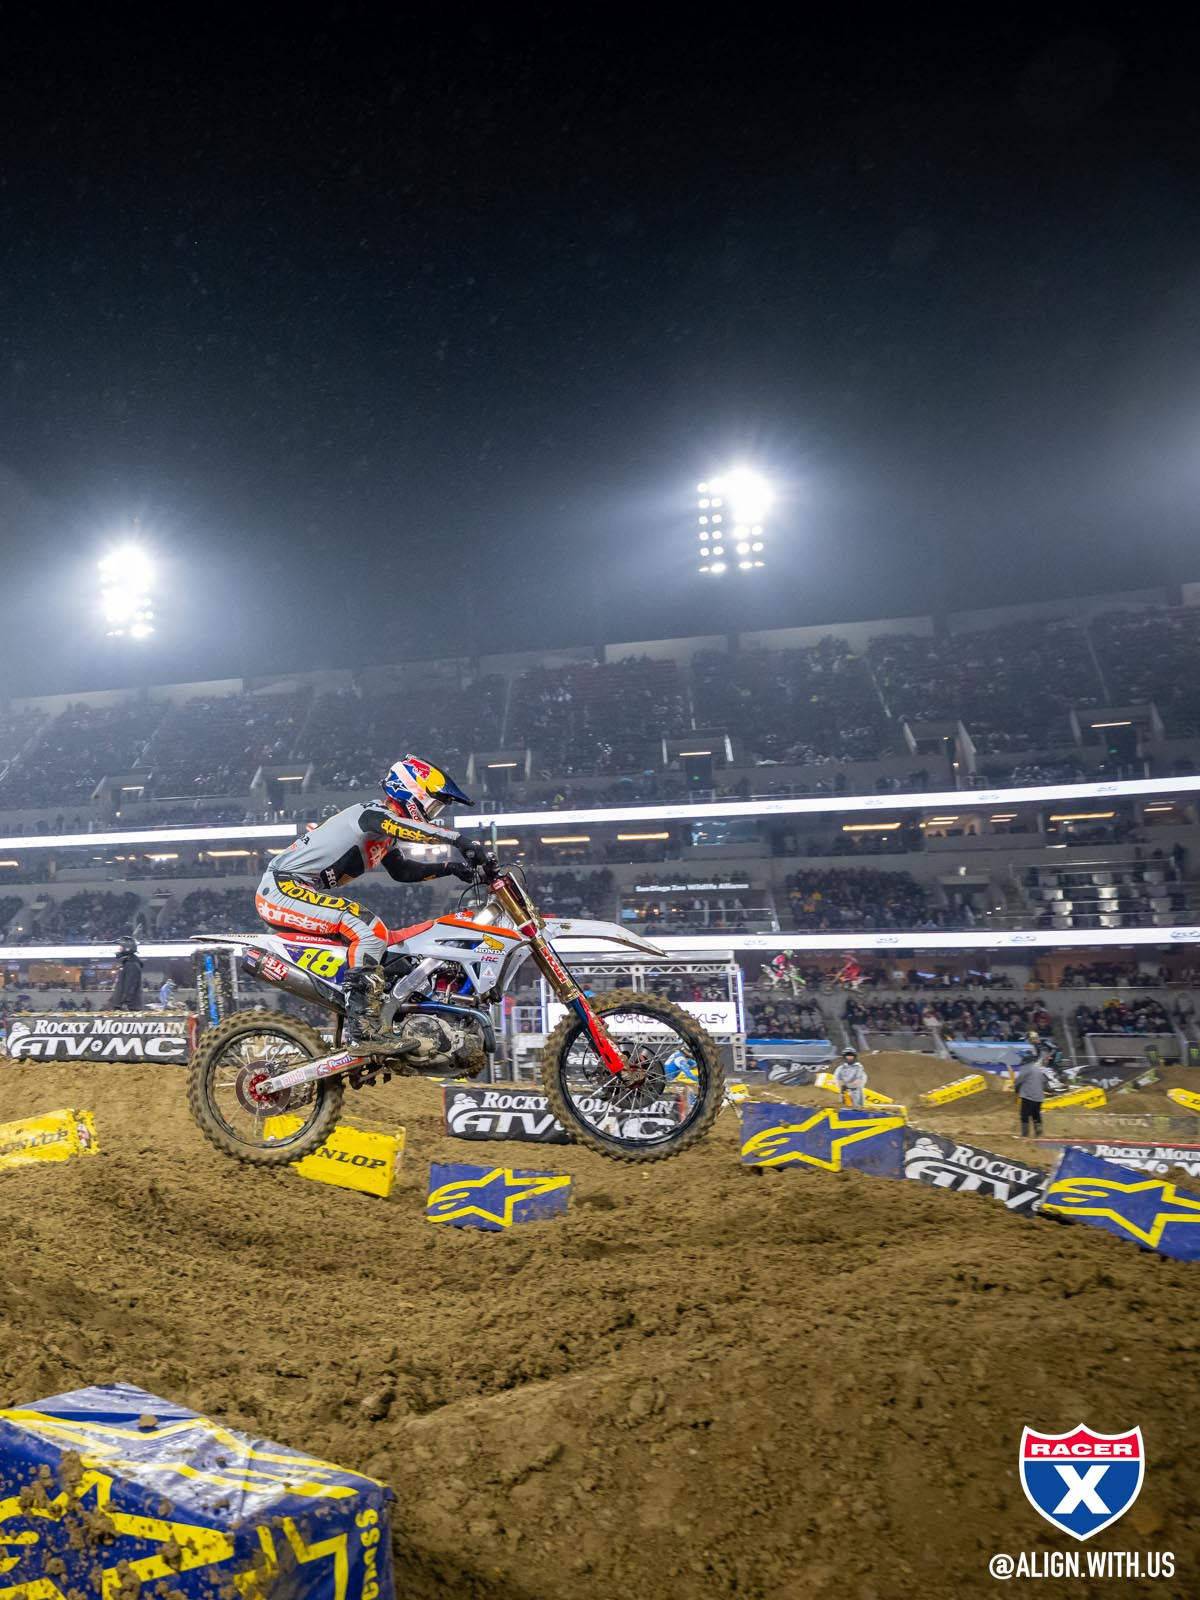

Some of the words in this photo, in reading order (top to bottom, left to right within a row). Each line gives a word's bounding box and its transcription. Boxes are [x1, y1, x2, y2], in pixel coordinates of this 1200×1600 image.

[278, 880, 360, 916] HONDA
[257, 902, 329, 933] alpinestars
[296, 935, 332, 943] HONDA
[474, 948, 506, 956] HONDA
[296, 948, 345, 978] 18
[33, 1019, 89, 1035] ROCKY
[90, 1020, 186, 1036] MOUNTAIN
[692, 1013, 728, 1024] KLEY
[328, 1054, 356, 1068] Renth
[480, 1091, 548, 1111] ROCKY
[320, 1146, 386, 1170] NLOP
[1094, 1145, 1152, 1158] ROCKY
[946, 1145, 1039, 1185] ROCKY
